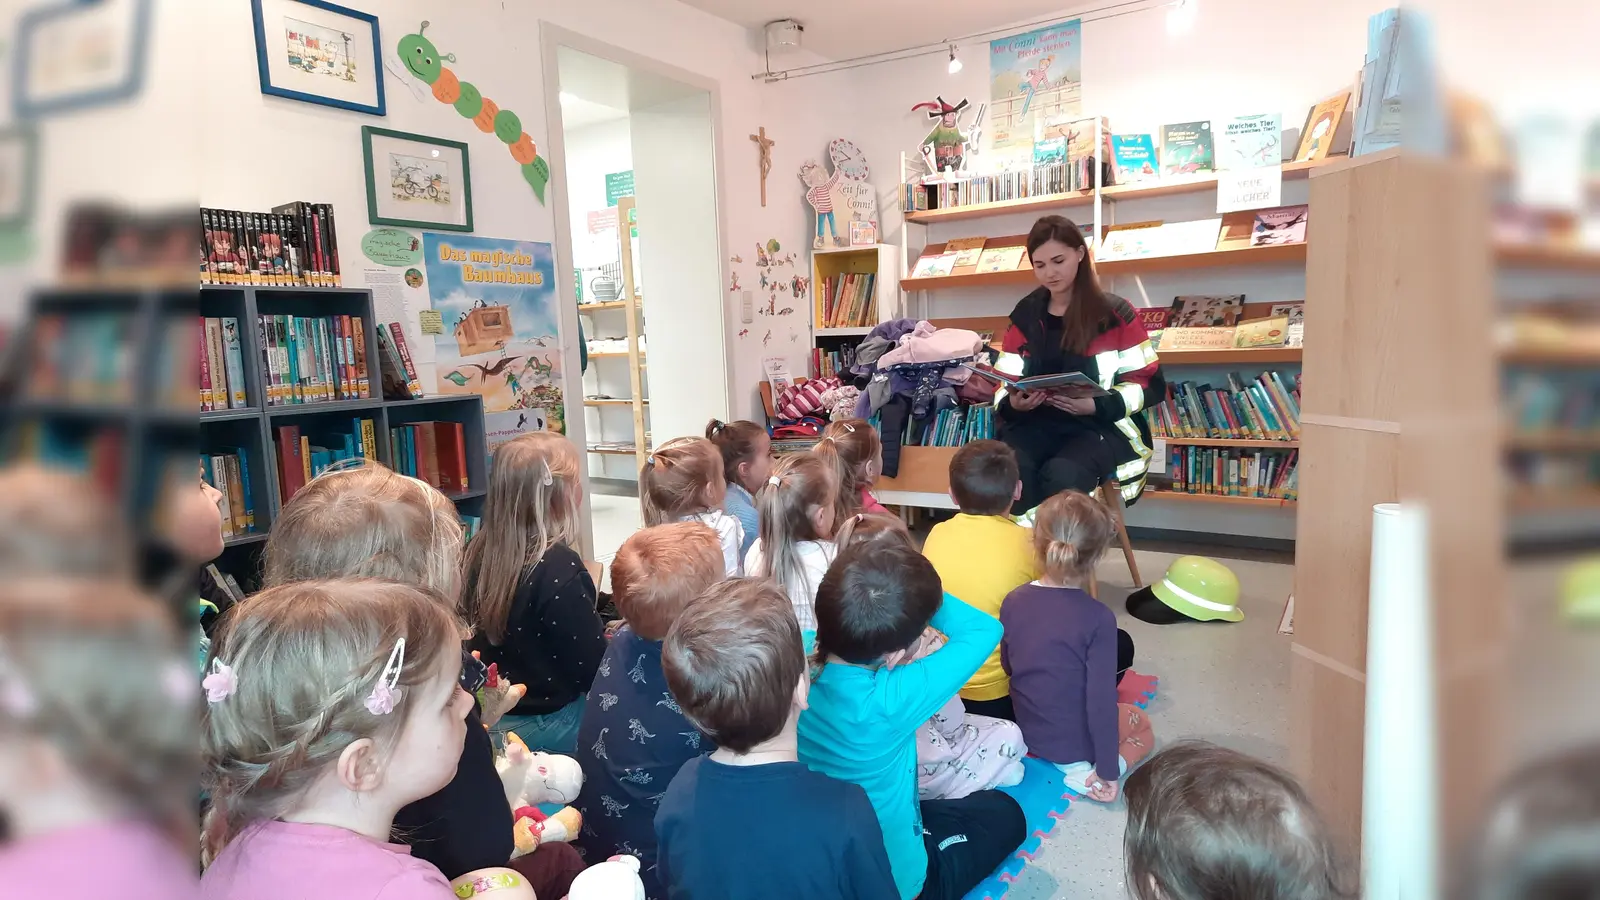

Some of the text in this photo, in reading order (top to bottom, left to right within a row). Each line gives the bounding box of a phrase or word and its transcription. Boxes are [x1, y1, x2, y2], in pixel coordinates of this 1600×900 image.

[1008, 36, 1036, 52] Conni
[1017, 41, 1071, 59] Pferde stehlen
[1227, 122, 1257, 130] Welches
[847, 197, 874, 210] Conni!
[439, 244, 532, 267] Das magische
[462, 264, 543, 284] Baumhaus
